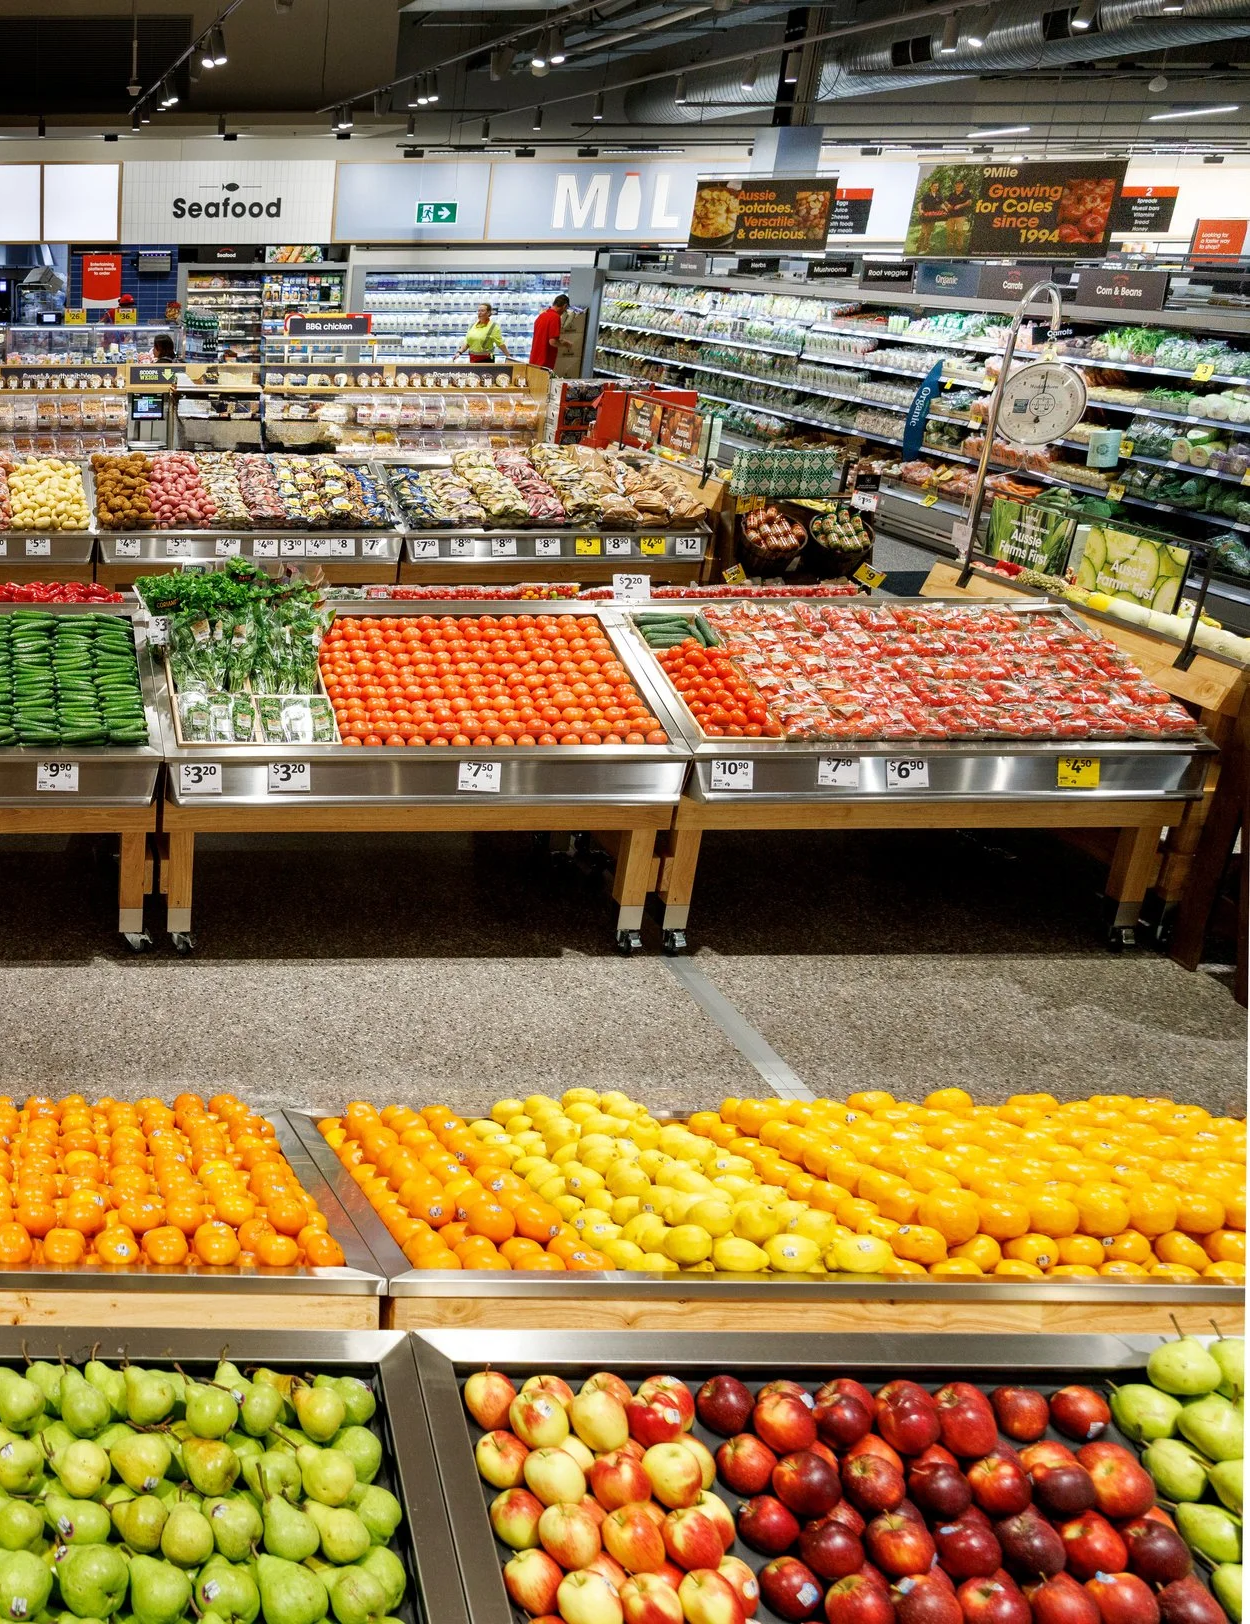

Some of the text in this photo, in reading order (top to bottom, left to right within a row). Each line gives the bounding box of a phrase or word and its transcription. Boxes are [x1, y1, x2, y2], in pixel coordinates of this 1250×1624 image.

[983, 167, 1018, 178] 9Mile
[737, 190, 776, 200] Aussie
[989, 183, 1063, 201] Growing
[1146, 187, 1152, 197] 2
[172, 197, 281, 219] Seafood
[738, 202, 794, 213] potatoes.
[975, 199, 1053, 213] for Coles
[744, 216, 795, 227] Versatile
[992, 214, 1039, 228] since
[736, 229, 806, 239] & delicious.
[1020, 229, 1060, 243] 1994
[883, 269, 908, 277] veggies
[935, 274, 958, 285] Organic
[1002, 281, 1023, 290] Carrots
[1096, 286, 1142, 297] Corn & Beans
[305, 322, 352, 330] BBQ chicken
[910, 386, 931, 427] Organic
[583, 538, 592, 548] $5
[679, 538, 696, 549] $12
[1011, 528, 1042, 548] Aussie
[337, 539, 347, 549] $8
[999, 540, 1048, 566] Farms First
[866, 570, 876, 581] $9
[1111, 559, 1148, 581] Aussie
[1096, 571, 1155, 601] Farms First
